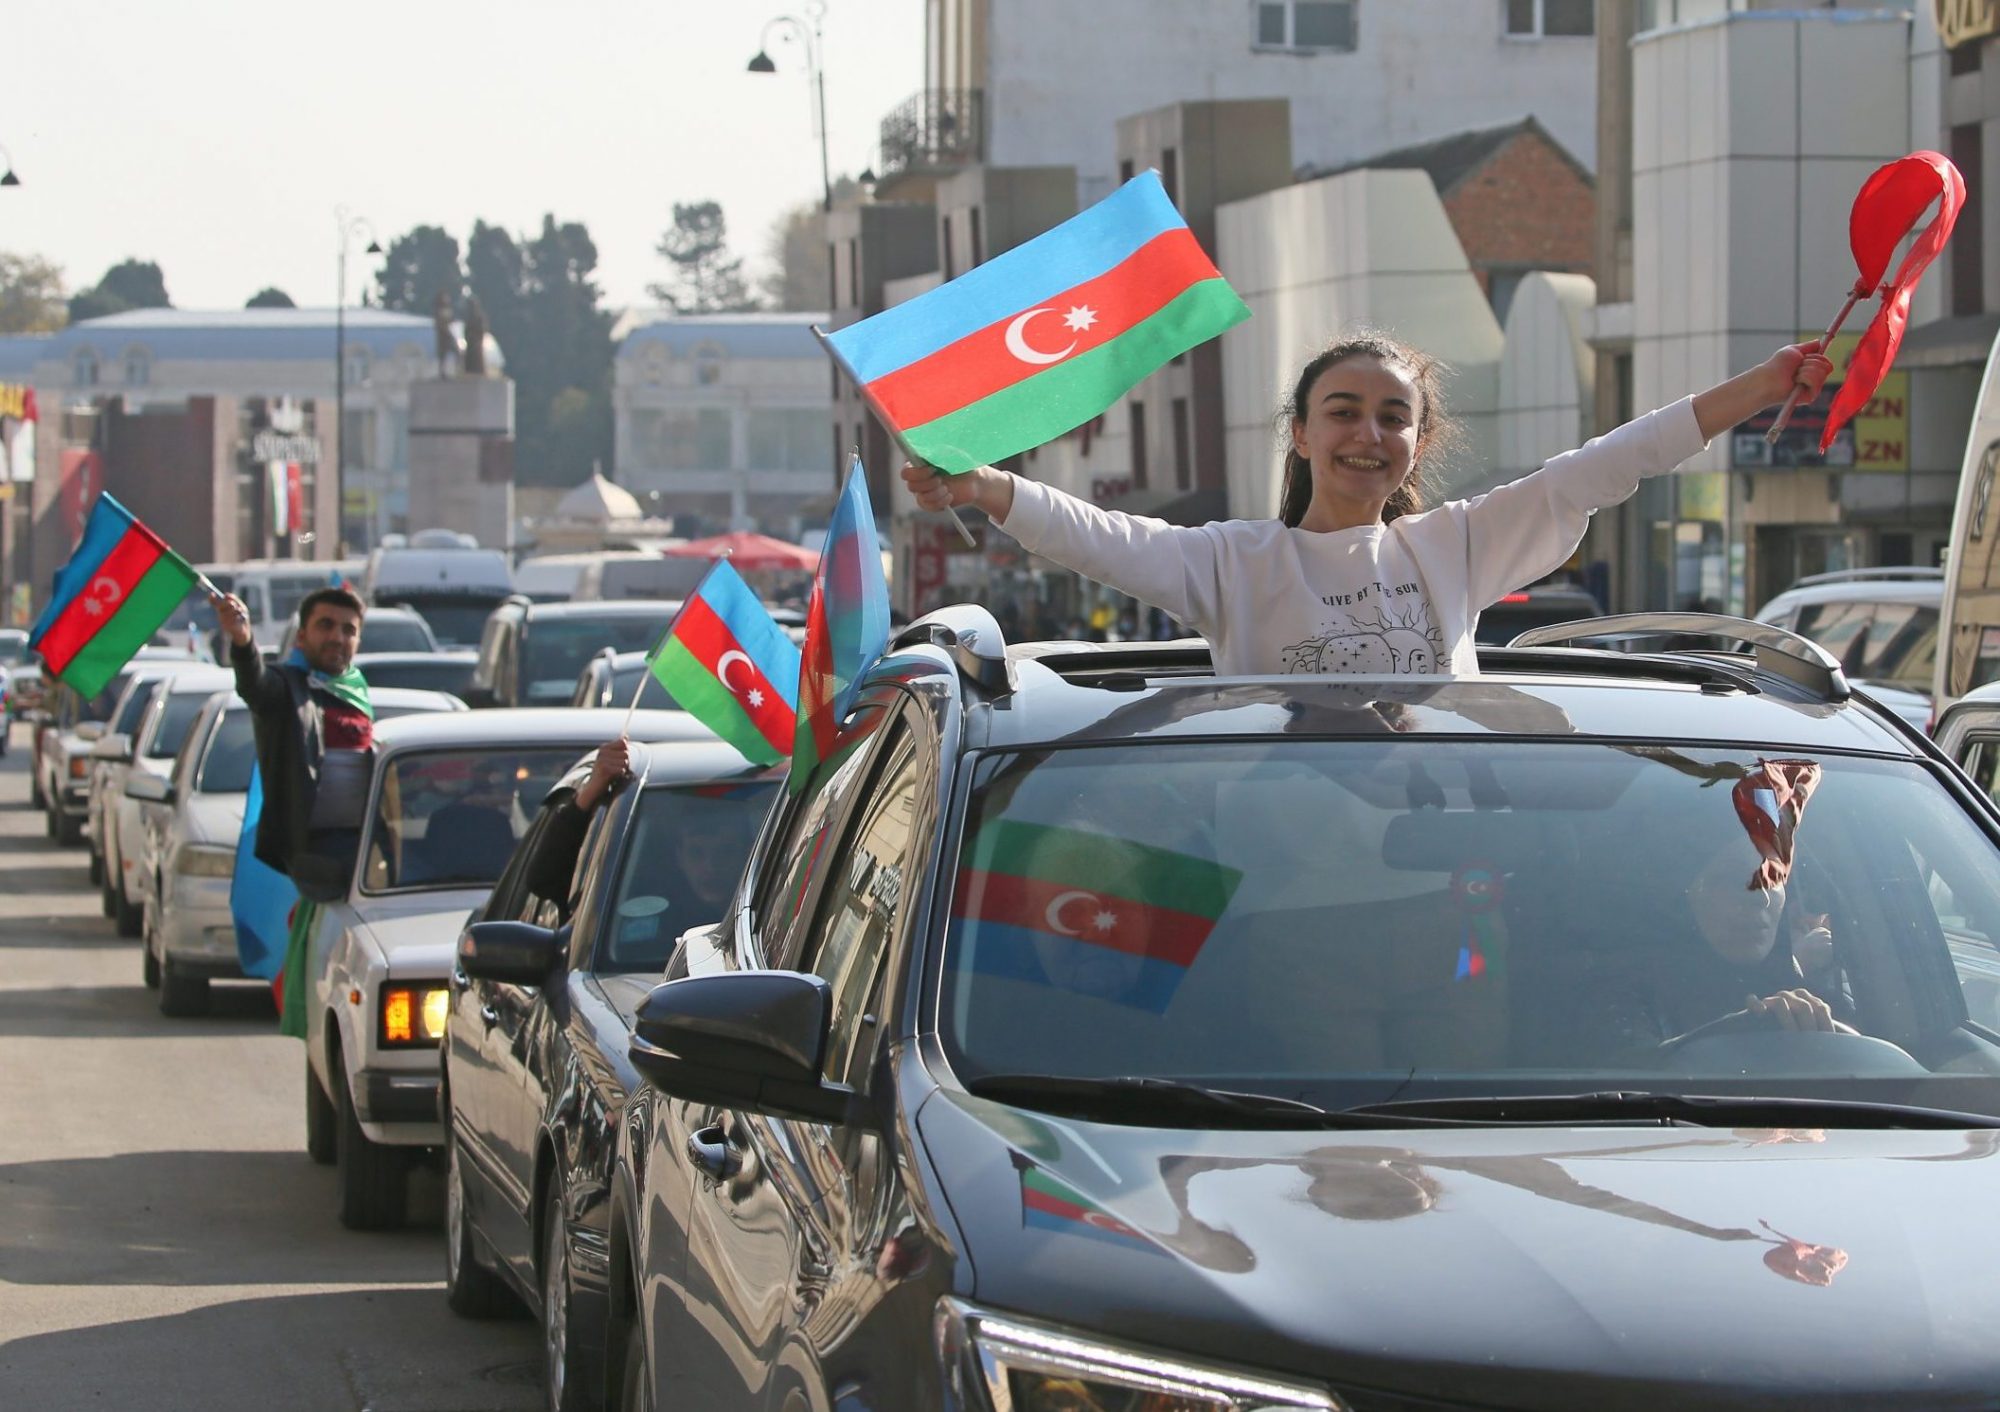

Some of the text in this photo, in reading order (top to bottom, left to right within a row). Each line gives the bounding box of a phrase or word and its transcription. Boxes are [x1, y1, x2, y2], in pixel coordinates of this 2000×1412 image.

[1322, 594, 1352, 606] LIVE
[1356, 586, 1368, 602] BY
[1395, 582, 1420, 596] SUN
